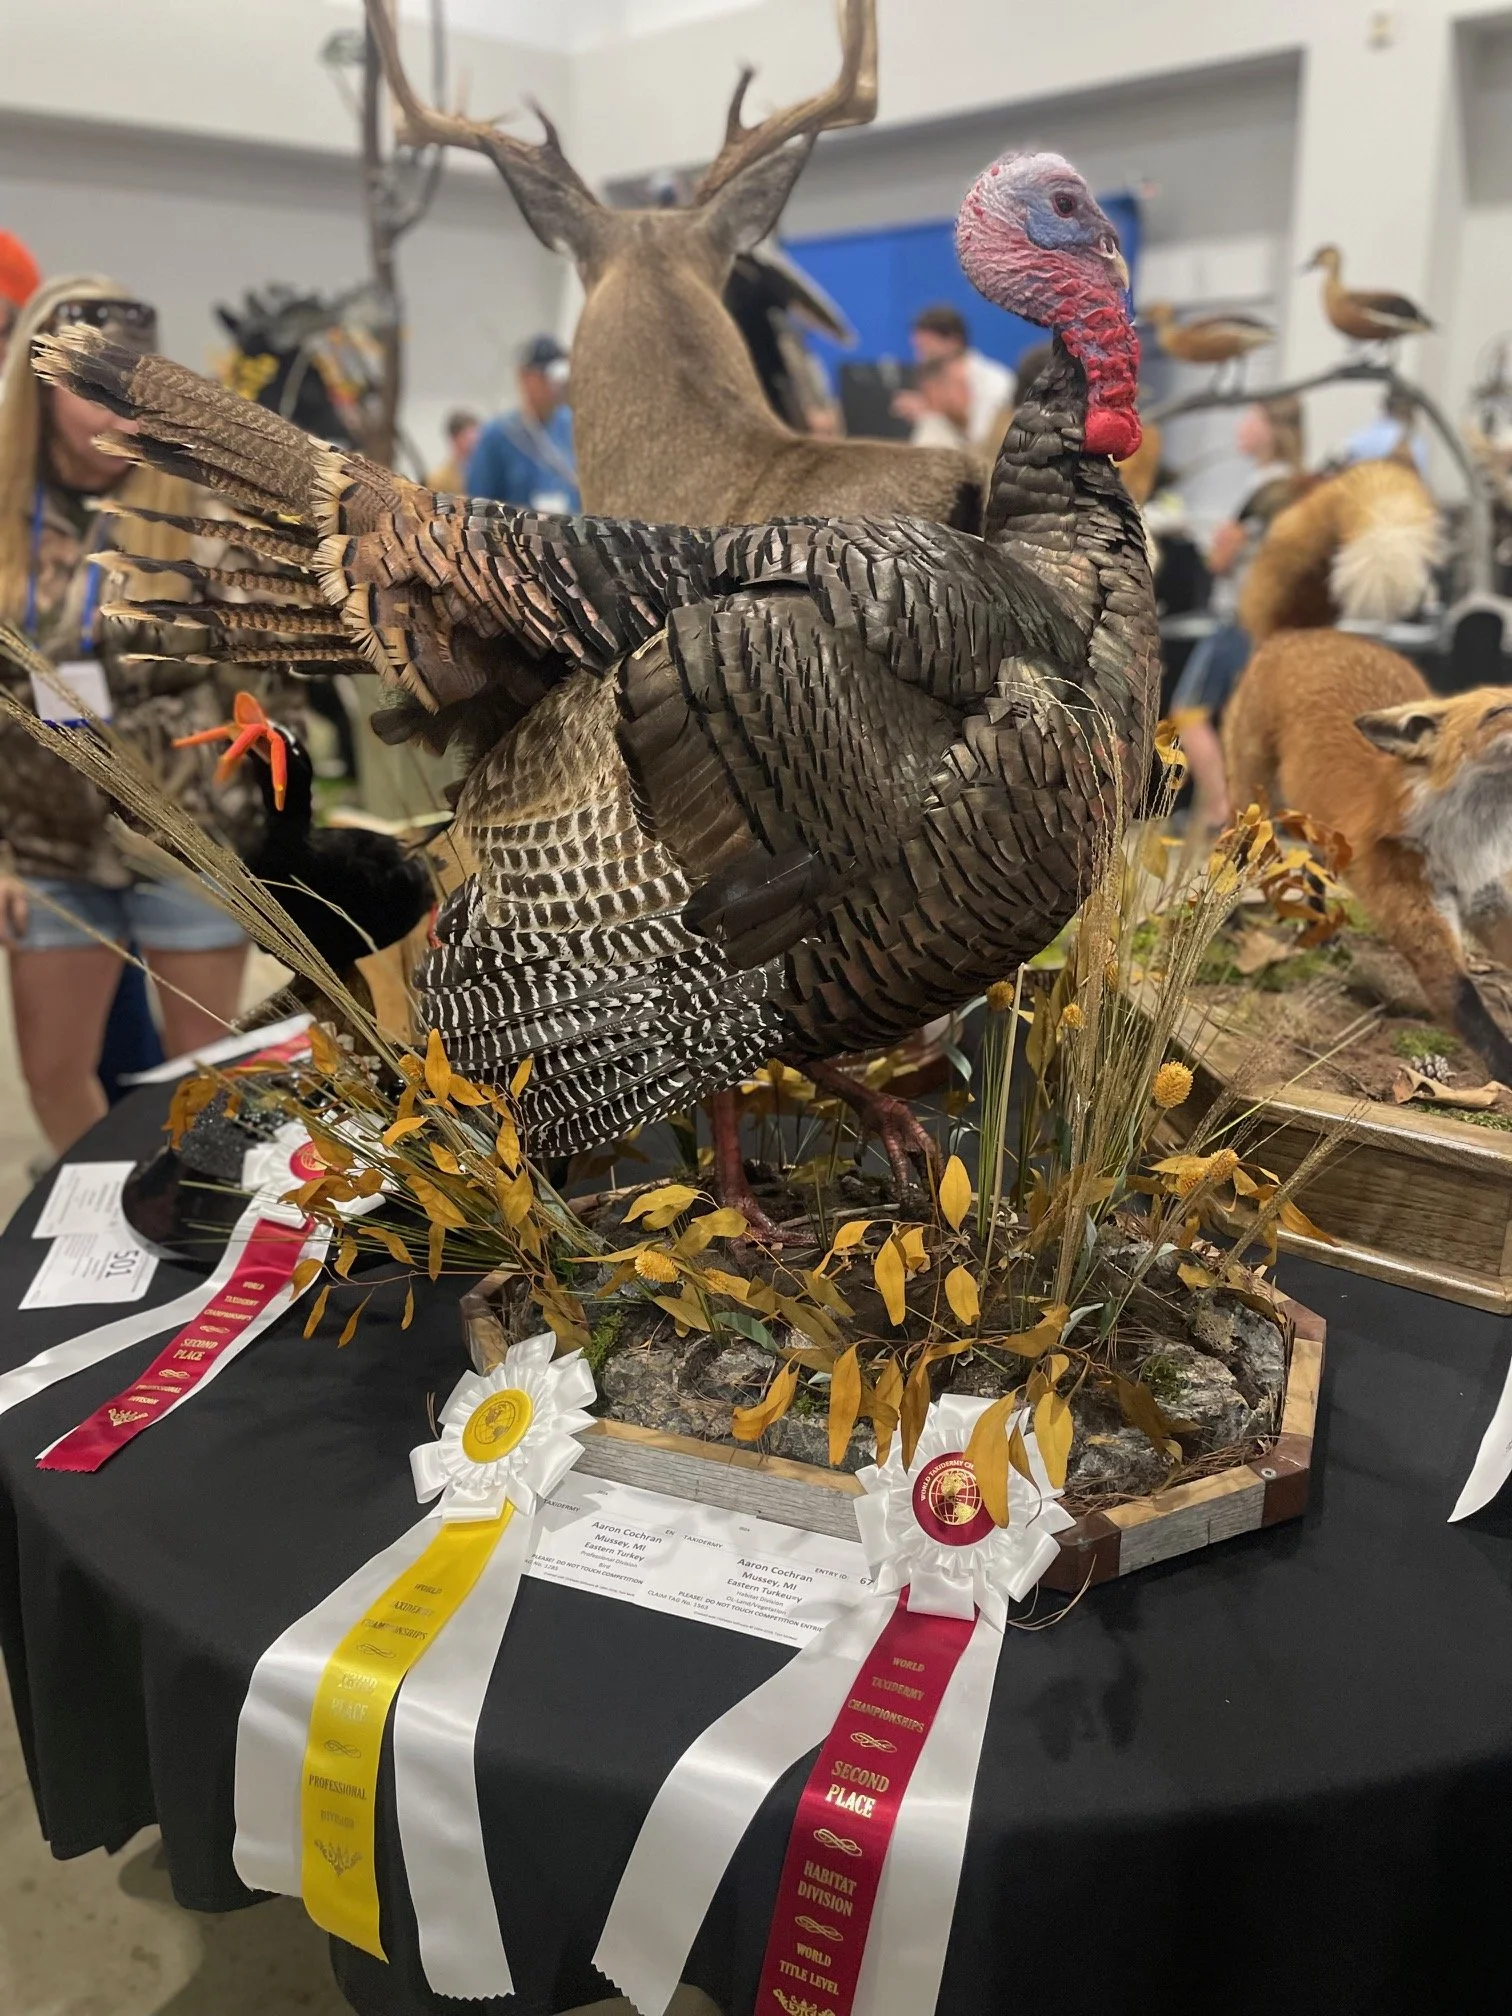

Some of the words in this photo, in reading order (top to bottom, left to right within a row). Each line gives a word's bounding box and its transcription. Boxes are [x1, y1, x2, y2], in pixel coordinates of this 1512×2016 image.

[105, 1250, 139, 1278] 501
[181, 1338, 218, 1349] SECOND
[174, 1349, 205, 1361] PLACE
[921, 1476, 931, 1502] WORLD
[929, 1460, 964, 1476] TAXIDERMY
[544, 1499, 581, 1512] TAXIDERMY
[592, 1522, 620, 1534] Aaron
[623, 1528, 662, 1544] Cochran
[594, 1534, 630, 1549] Mussey,
[632, 1542, 646, 1552] MI
[684, 1534, 723, 1548] TAXIDERMY
[581, 1550, 614, 1562] Professional
[615, 1559, 638, 1568] Division
[584, 1542, 614, 1554] Eastern
[617, 1550, 644, 1562] Turkey
[532, 1554, 555, 1562] PLEASE!
[580, 1565, 600, 1575] TOUCH
[602, 1571, 644, 1585] COMPETITION
[599, 1562, 610, 1570] Bird
[737, 1558, 768, 1572] Aaron
[771, 1566, 813, 1582] Cochran
[815, 1568, 838, 1578] ENTRY
[414, 1584, 442, 1594] WORLD
[727, 1578, 760, 1592] Eastern
[742, 1572, 780, 1588] Mussey,
[783, 1582, 797, 1590] MI
[648, 1590, 667, 1599] CLAIM
[693, 1602, 708, 1610] 1563
[678, 1590, 703, 1601] PLEASE!
[716, 1600, 730, 1608] NOT
[732, 1604, 754, 1614] TOUCH
[754, 1611, 799, 1626] COMPETITION
[736, 1591, 758, 1600] Habitat
[760, 1596, 784, 1606] Division
[892, 1657, 926, 1672] WORLD
[872, 1676, 925, 1701] TAXIDERMY
[848, 1699, 925, 1734] CHAMPIONSHIPS
[831, 1760, 890, 1793] SECOND
[309, 1774, 367, 1800] PROFESSIONAL
[826, 1784, 876, 1818] PLACE
[320, 1810, 355, 1830] DIVISION
[804, 1860, 857, 1896] HABITAT
[798, 1880, 854, 1917] DIVISION
[796, 1942, 832, 1968] WORLD
[780, 1960, 808, 1982] TITLE
[809, 1972, 839, 1996] LEVEL
